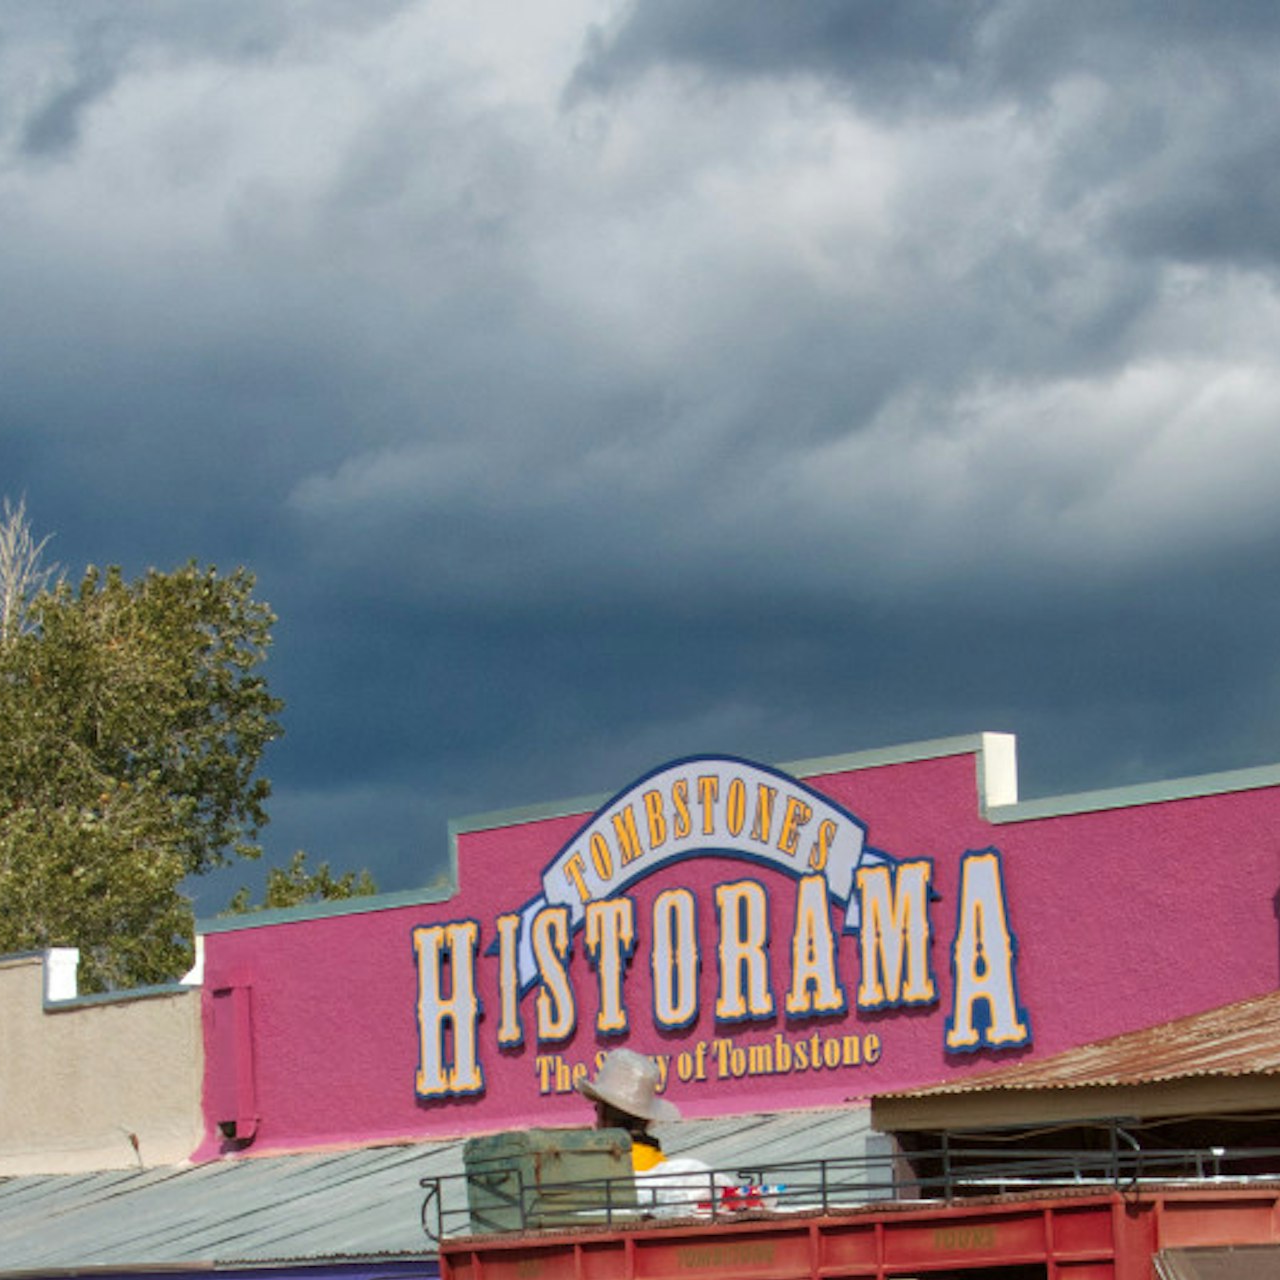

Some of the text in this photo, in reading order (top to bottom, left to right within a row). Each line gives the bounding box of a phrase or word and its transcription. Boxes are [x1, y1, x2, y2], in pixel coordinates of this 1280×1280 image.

[563, 774, 839, 904] TOMBSTONE'S
[412, 847, 1033, 1099] HISTORAMA
[535, 1054, 587, 1096] The
[676, 1040, 708, 1082] of
[711, 1031, 881, 1080] Tombstone
